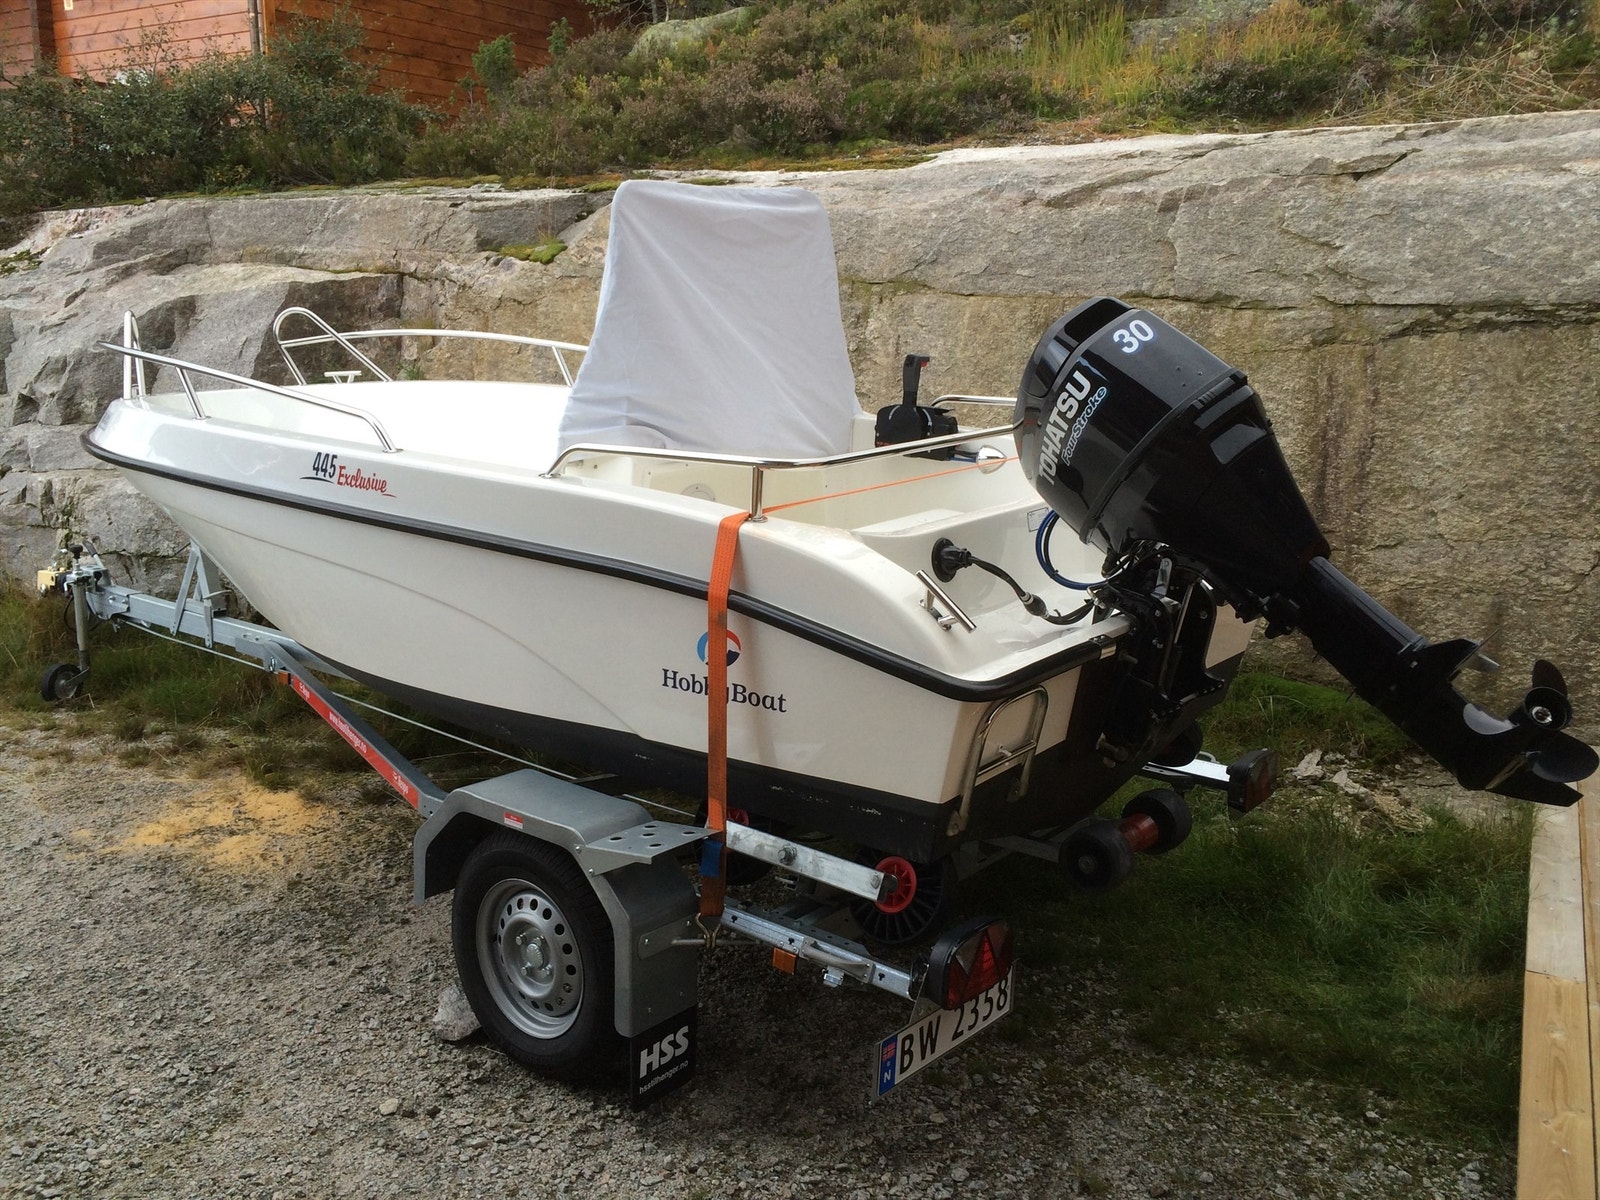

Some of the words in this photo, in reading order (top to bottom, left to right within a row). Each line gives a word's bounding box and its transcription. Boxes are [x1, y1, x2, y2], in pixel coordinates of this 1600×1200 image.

[1113, 319, 1154, 353] 30
[1039, 370, 1091, 485] TOHATSU
[1061, 386, 1107, 466] FourStroke
[312, 451, 338, 479] 445
[337, 465, 387, 493] Exclusive
[662, 668, 787, 713] HobBoat
[900, 1015, 942, 1075] BW
[952, 977, 1008, 1042] 2358
[639, 1025, 689, 1079] HSS
[883, 1069, 891, 1084] N
